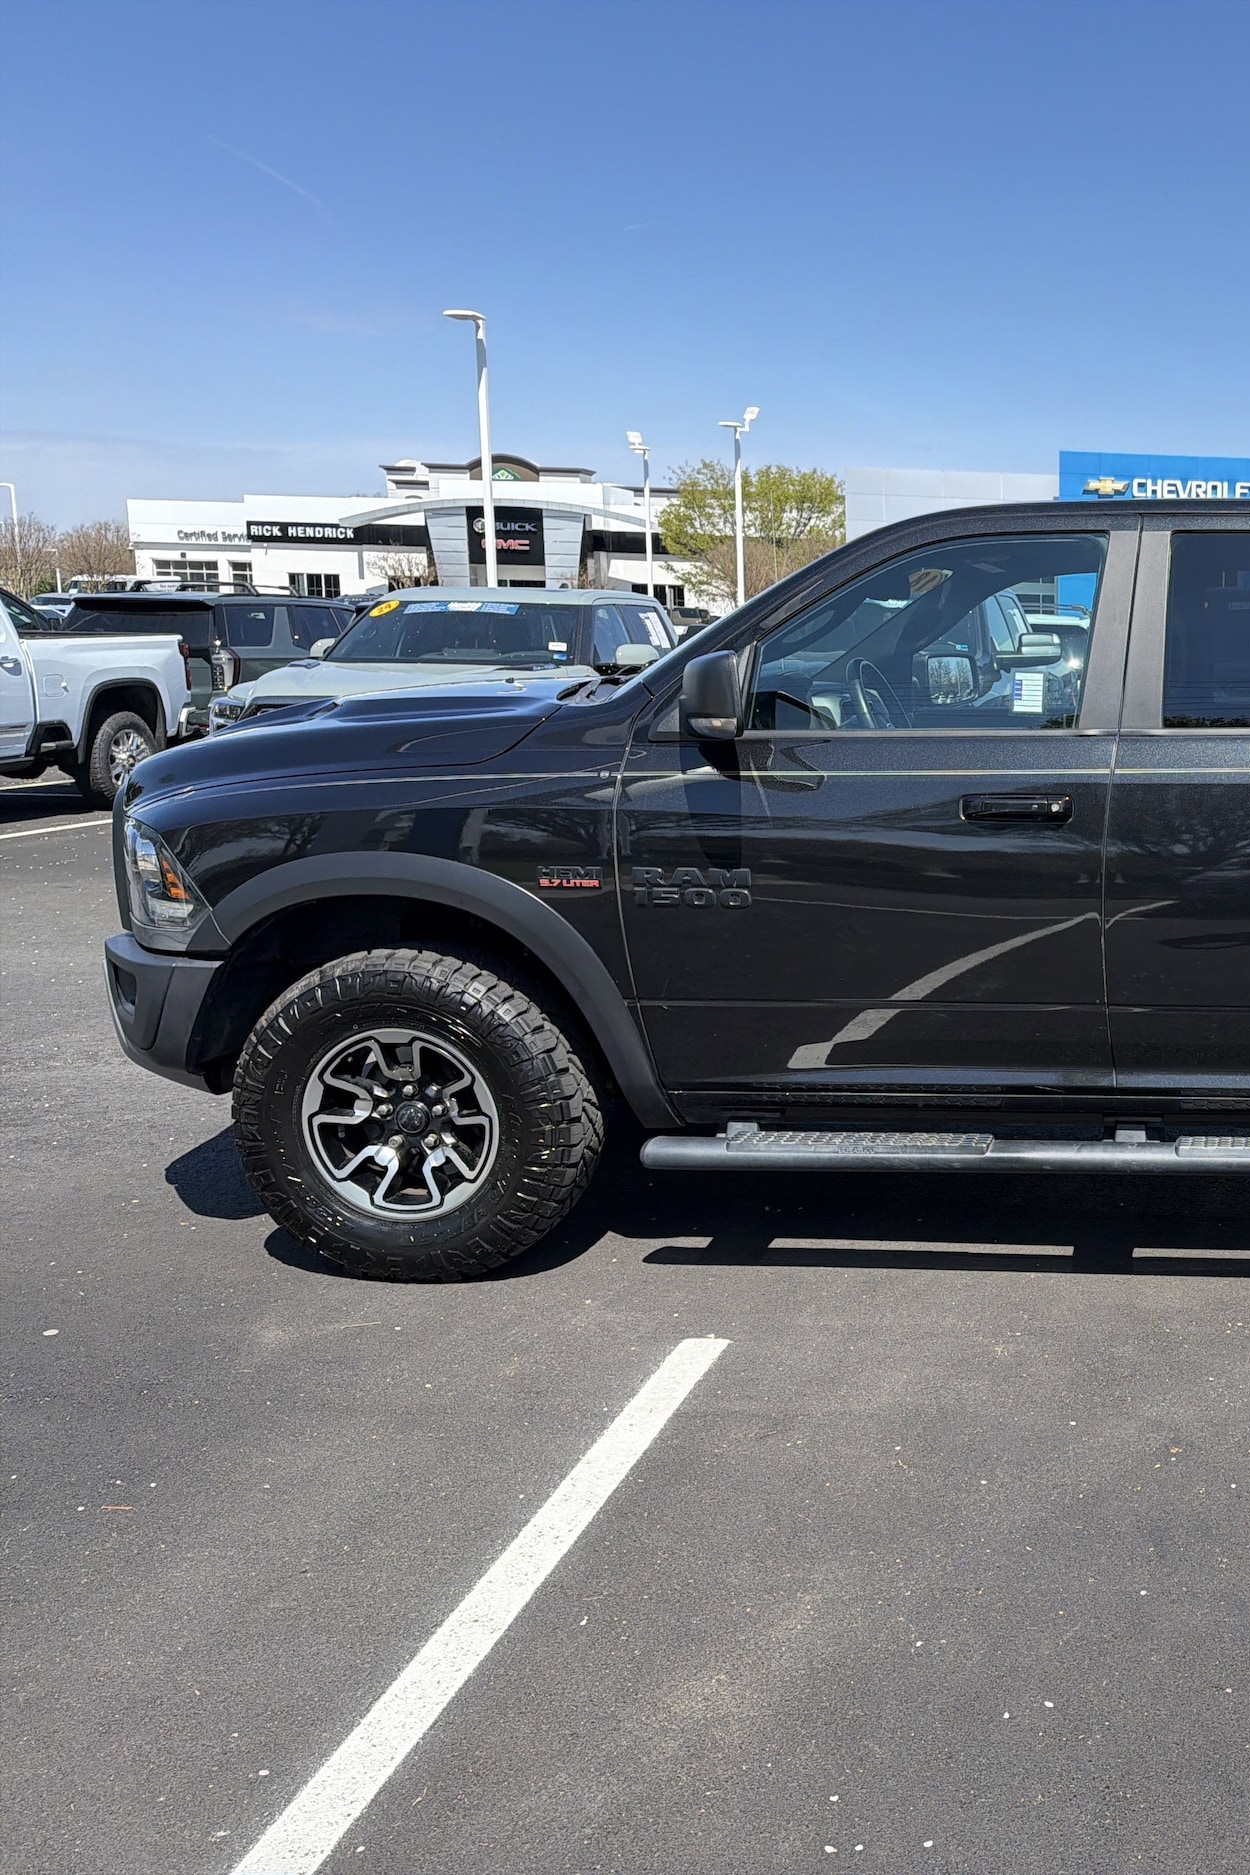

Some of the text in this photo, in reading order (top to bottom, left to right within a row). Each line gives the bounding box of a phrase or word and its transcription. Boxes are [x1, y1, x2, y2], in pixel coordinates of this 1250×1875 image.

[177, 530, 219, 542] Certified
[250, 525, 354, 539] RICK HENDRICK
[537, 865, 603, 879] HEMI
[631, 866, 752, 888] RAM
[539, 878, 600, 888] 5.7 LITER
[632, 886, 752, 909] 1500
